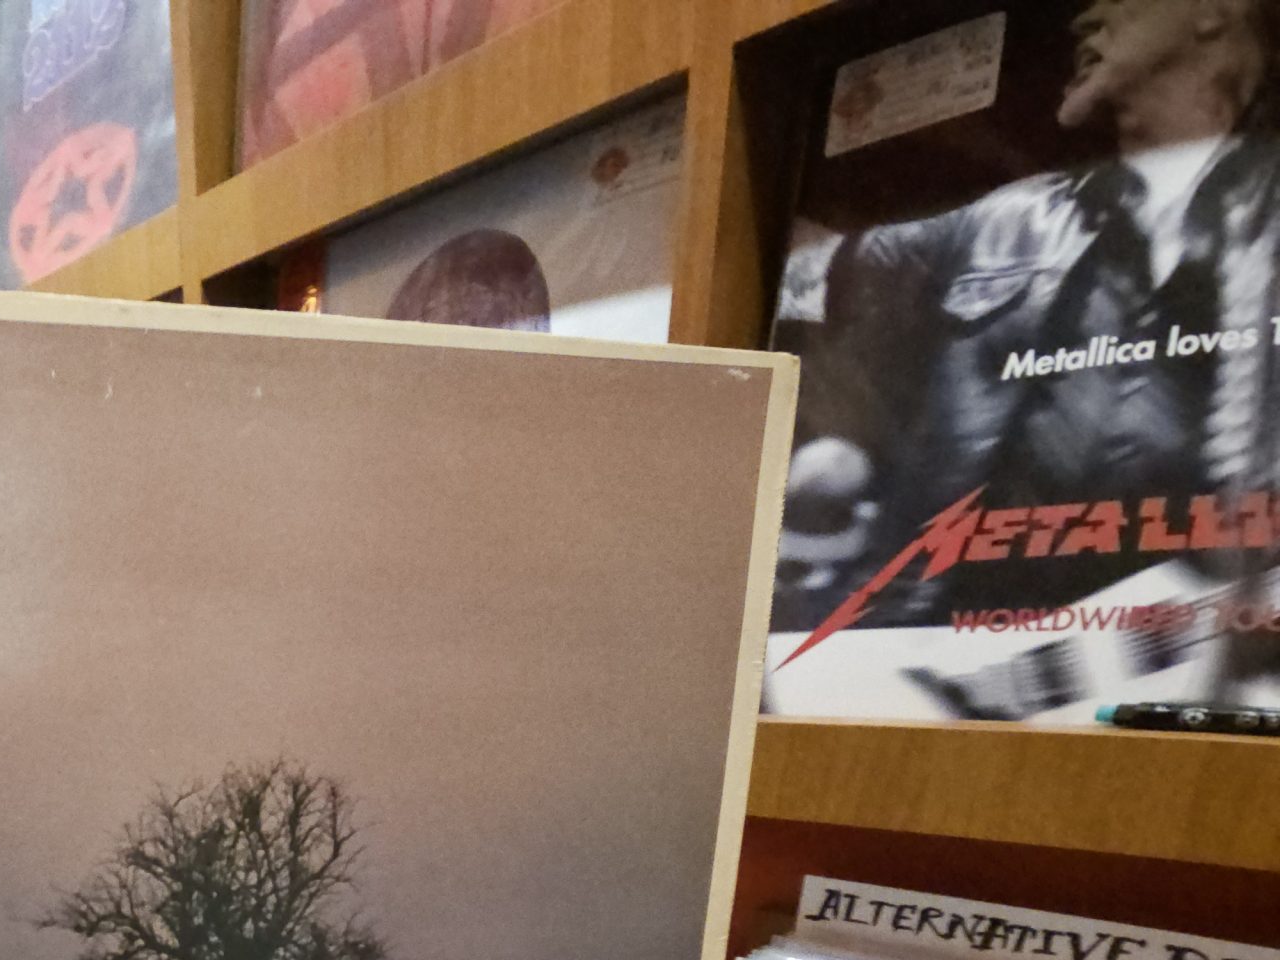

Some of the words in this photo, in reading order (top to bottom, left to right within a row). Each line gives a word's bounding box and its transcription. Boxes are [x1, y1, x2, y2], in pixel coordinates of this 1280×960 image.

[1000, 334, 1157, 381] Metallica
[1166, 325, 1259, 358] loves
[774, 483, 1280, 672] METALLI
